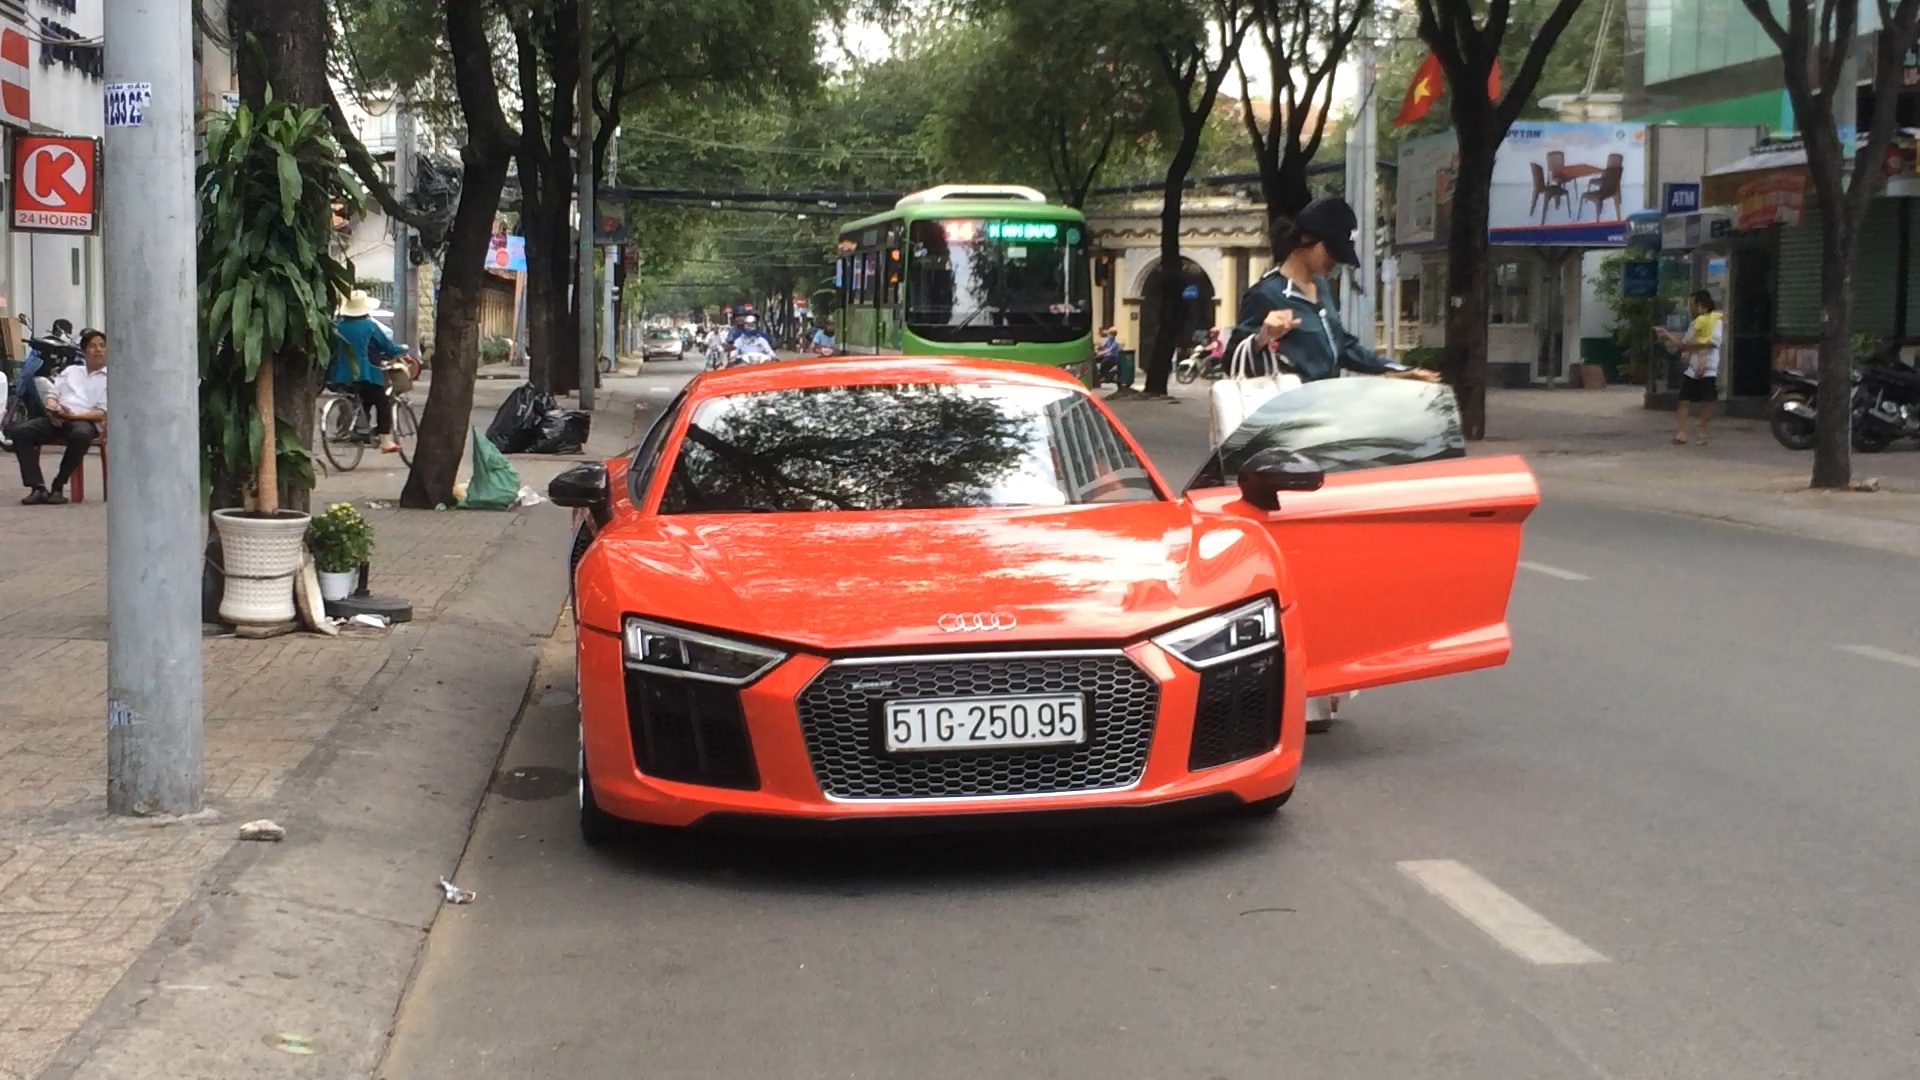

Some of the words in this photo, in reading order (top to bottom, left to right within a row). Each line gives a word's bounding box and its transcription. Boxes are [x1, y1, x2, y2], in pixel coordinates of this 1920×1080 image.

[34, 148, 81, 206] K
[1671, 190, 1695, 207] ATM
[20, 213, 35, 224] 24
[38, 214, 88, 227] HOURS
[892, 702, 1077, 744] 51G-250.95
